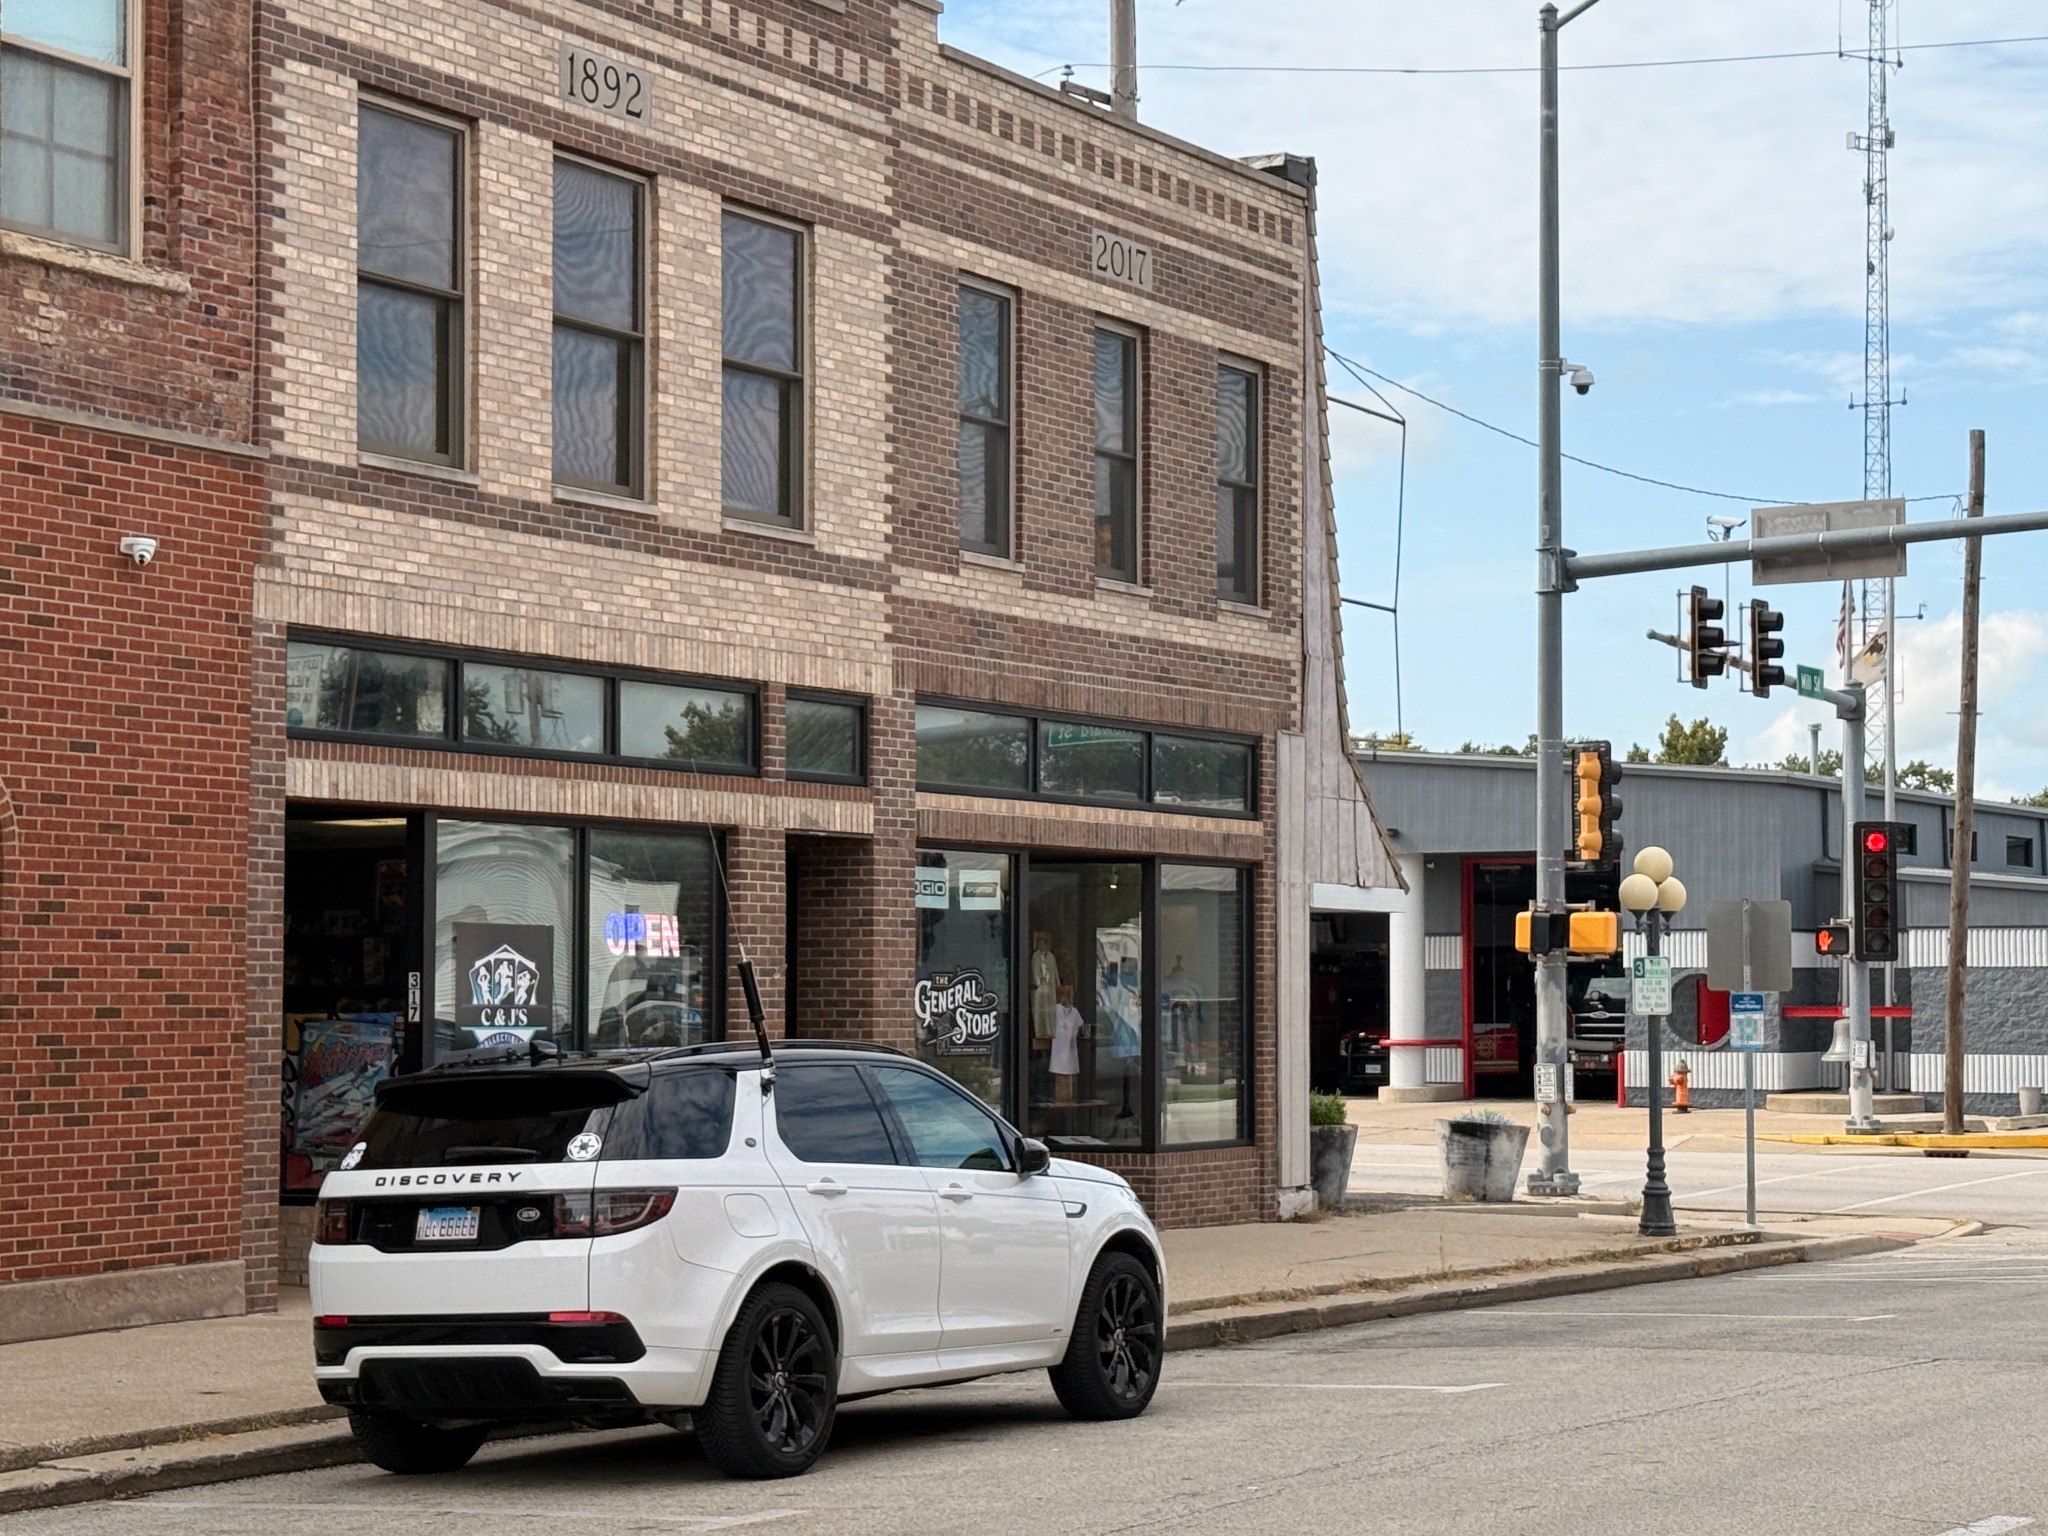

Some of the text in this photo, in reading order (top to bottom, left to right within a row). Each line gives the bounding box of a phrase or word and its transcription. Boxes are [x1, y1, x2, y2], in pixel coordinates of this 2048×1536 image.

[567, 52, 643, 119] 1892
[1096, 234, 1147, 285] 2017
[605, 911, 680, 957] OPEN
[936, 976, 949, 985] THE
[1635, 961, 1644, 976] 3
[410, 973, 419, 1021] 317
[481, 1008, 528, 1026] C & J'S
[914, 980, 982, 1028] GENERAL
[952, 1007, 998, 1044] STORE
[375, 1171, 522, 1187] DISCOVERY
